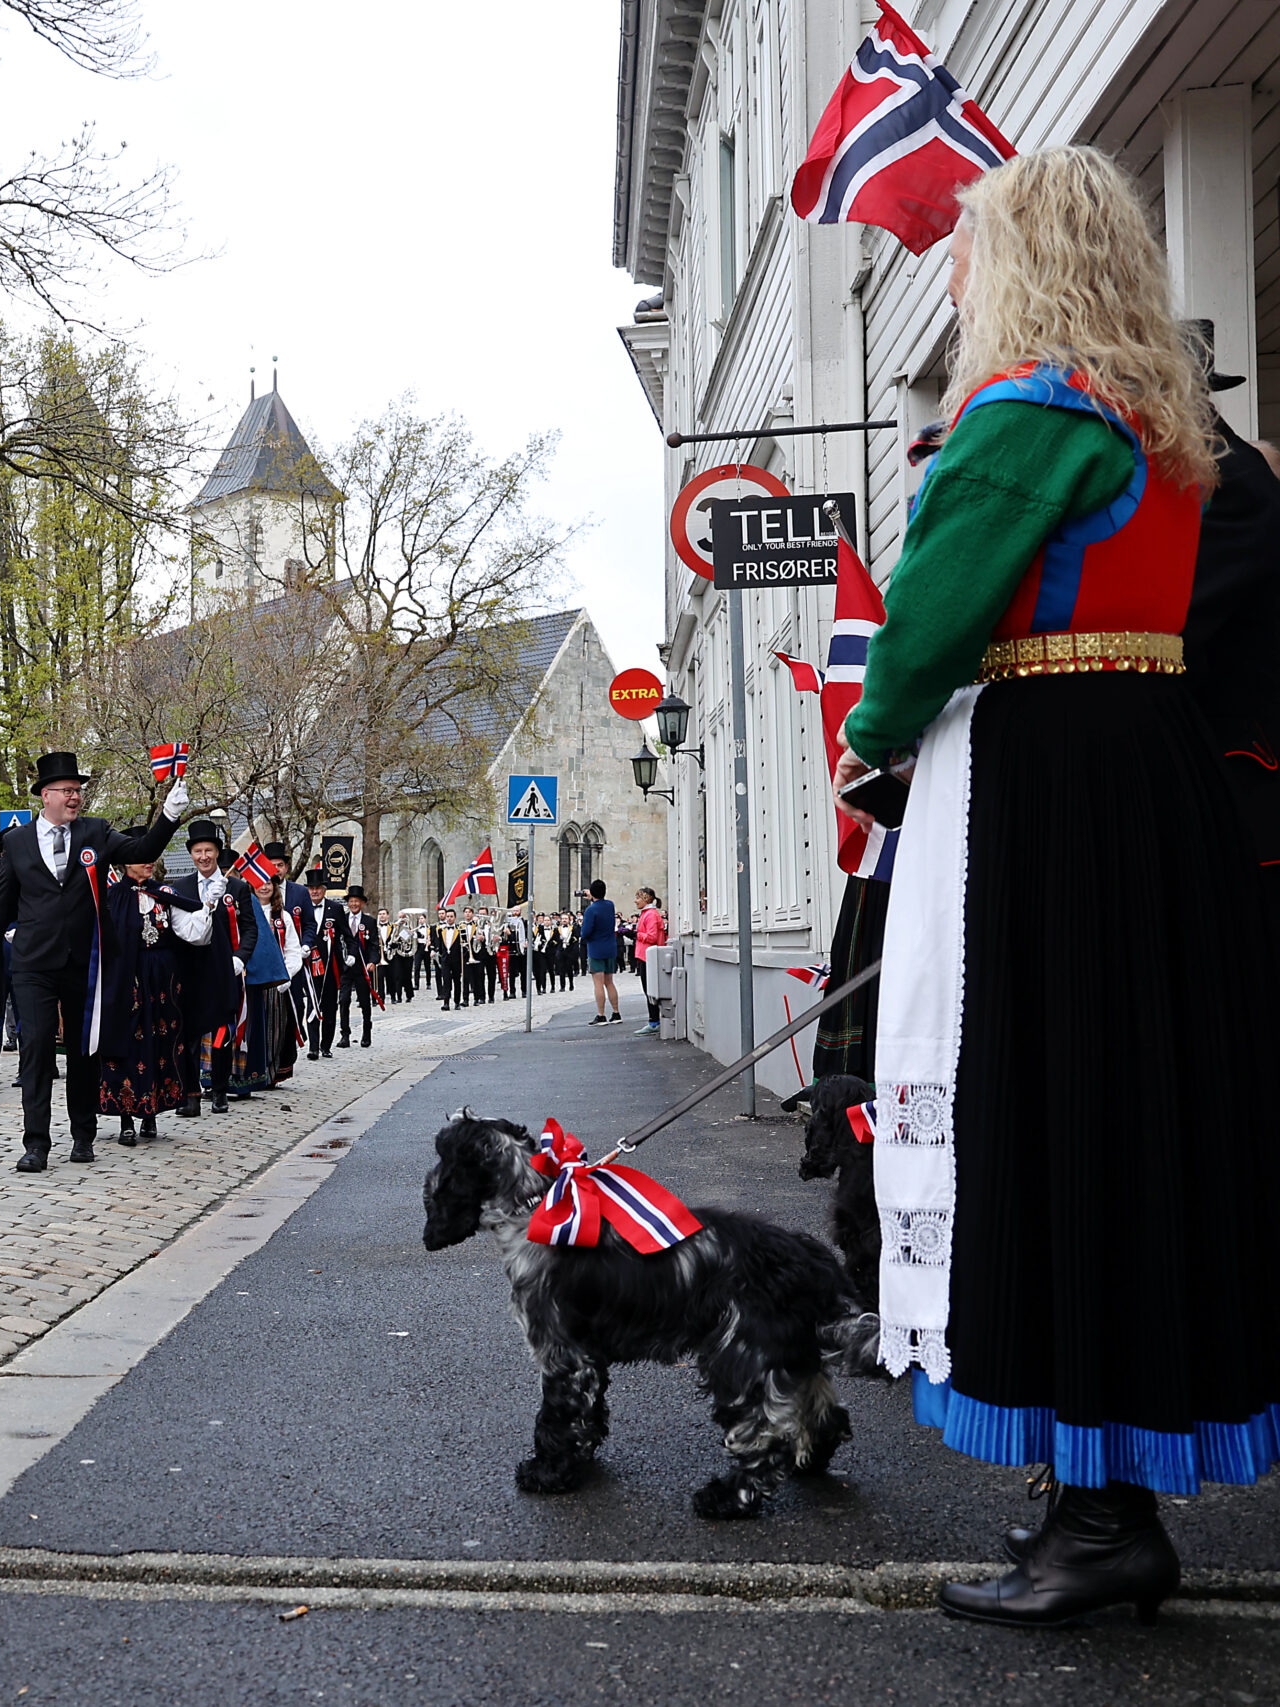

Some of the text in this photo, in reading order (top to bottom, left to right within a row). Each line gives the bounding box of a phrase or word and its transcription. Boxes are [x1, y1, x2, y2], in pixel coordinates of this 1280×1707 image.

[730, 507, 838, 544] TELL
[742, 539, 838, 551] ONLY YOUR BEST FRIENDS
[733, 558, 838, 581] FRISØRER
[612, 687, 659, 700] EXTRA
